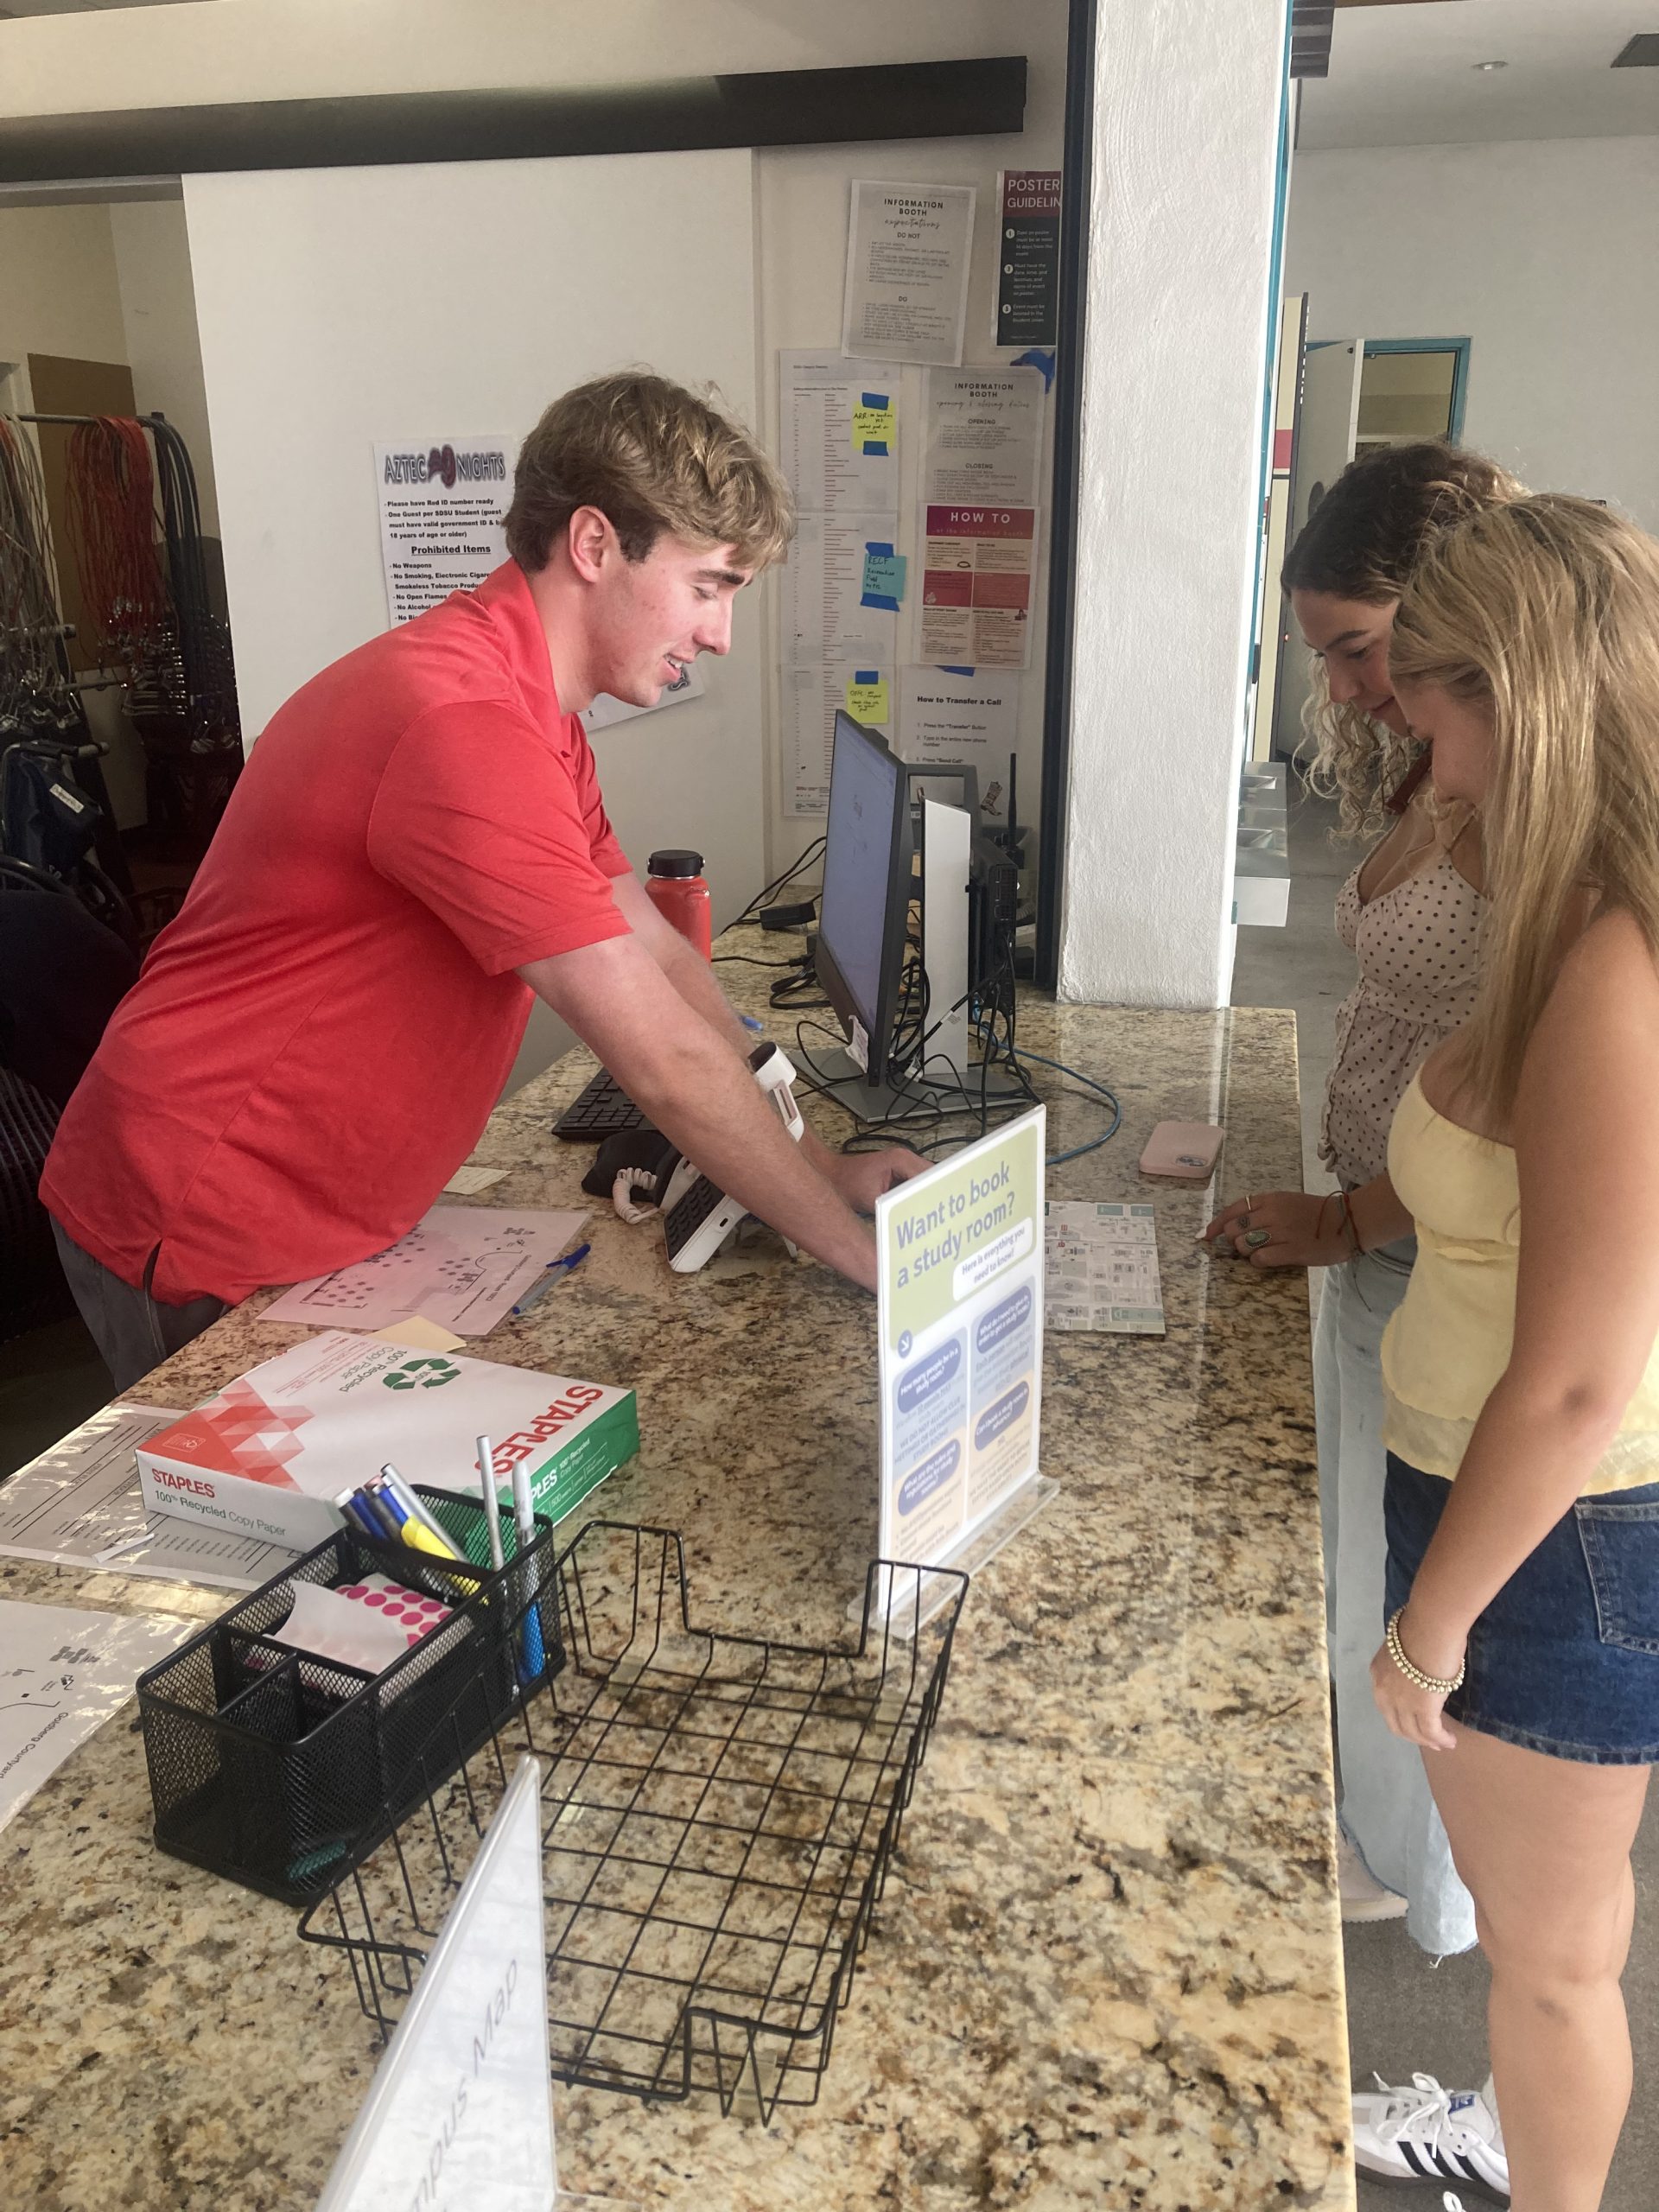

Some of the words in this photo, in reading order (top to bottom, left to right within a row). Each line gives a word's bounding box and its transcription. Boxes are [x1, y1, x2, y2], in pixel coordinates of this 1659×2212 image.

[1007, 179, 1060, 192] POSTER
[884, 198, 944, 209] INFORMATION
[1007, 197, 1061, 208] GUIDELIN
[385, 454, 427, 484] AZTEC
[456, 452, 506, 482] NIGHTS
[950, 512, 984, 523] HOW
[992, 513, 1010, 524] TO
[411, 545, 461, 555] Prohibited
[463, 545, 491, 554] Items
[897, 1201, 944, 1249] Want
[948, 1194, 965, 1218] to
[969, 1160, 1009, 1206] book
[897, 1267, 909, 1288] a
[913, 1230, 962, 1278] study
[966, 1191, 1015, 1243] room?
[962, 1261, 977, 1275] Here
[978, 1254, 983, 1265] is
[984, 1233, 1014, 1262] everything
[1014, 1226, 1026, 1241] you
[974, 1268, 989, 1283] need
[989, 1262, 997, 1273] to
[997, 1248, 1015, 1268] know!
[980, 1322, 991, 1336] What
[365, 1346, 395, 1362] Copy
[339, 1363, 387, 1392] Recycled
[340, 1361, 372, 1379] Paper
[901, 1384, 912, 1396] How
[912, 1372, 926, 1386] many
[916, 1379, 930, 1395] study
[474, 1385, 603, 1474] STAPLES
[152, 1468, 215, 1498] STAPLES
[531, 1469, 557, 1500] PLES
[905, 1478, 917, 1493] What
[156, 1490, 178, 1503] 100%
[180, 1497, 226, 1519] Recycled
[229, 1511, 254, 1529] Copy
[257, 1519, 286, 1535] Paper
[31, 1712, 68, 1742] Goldberg
[0, 1743, 36, 1778] Courtyard
[474, 1958, 517, 2077] Map
